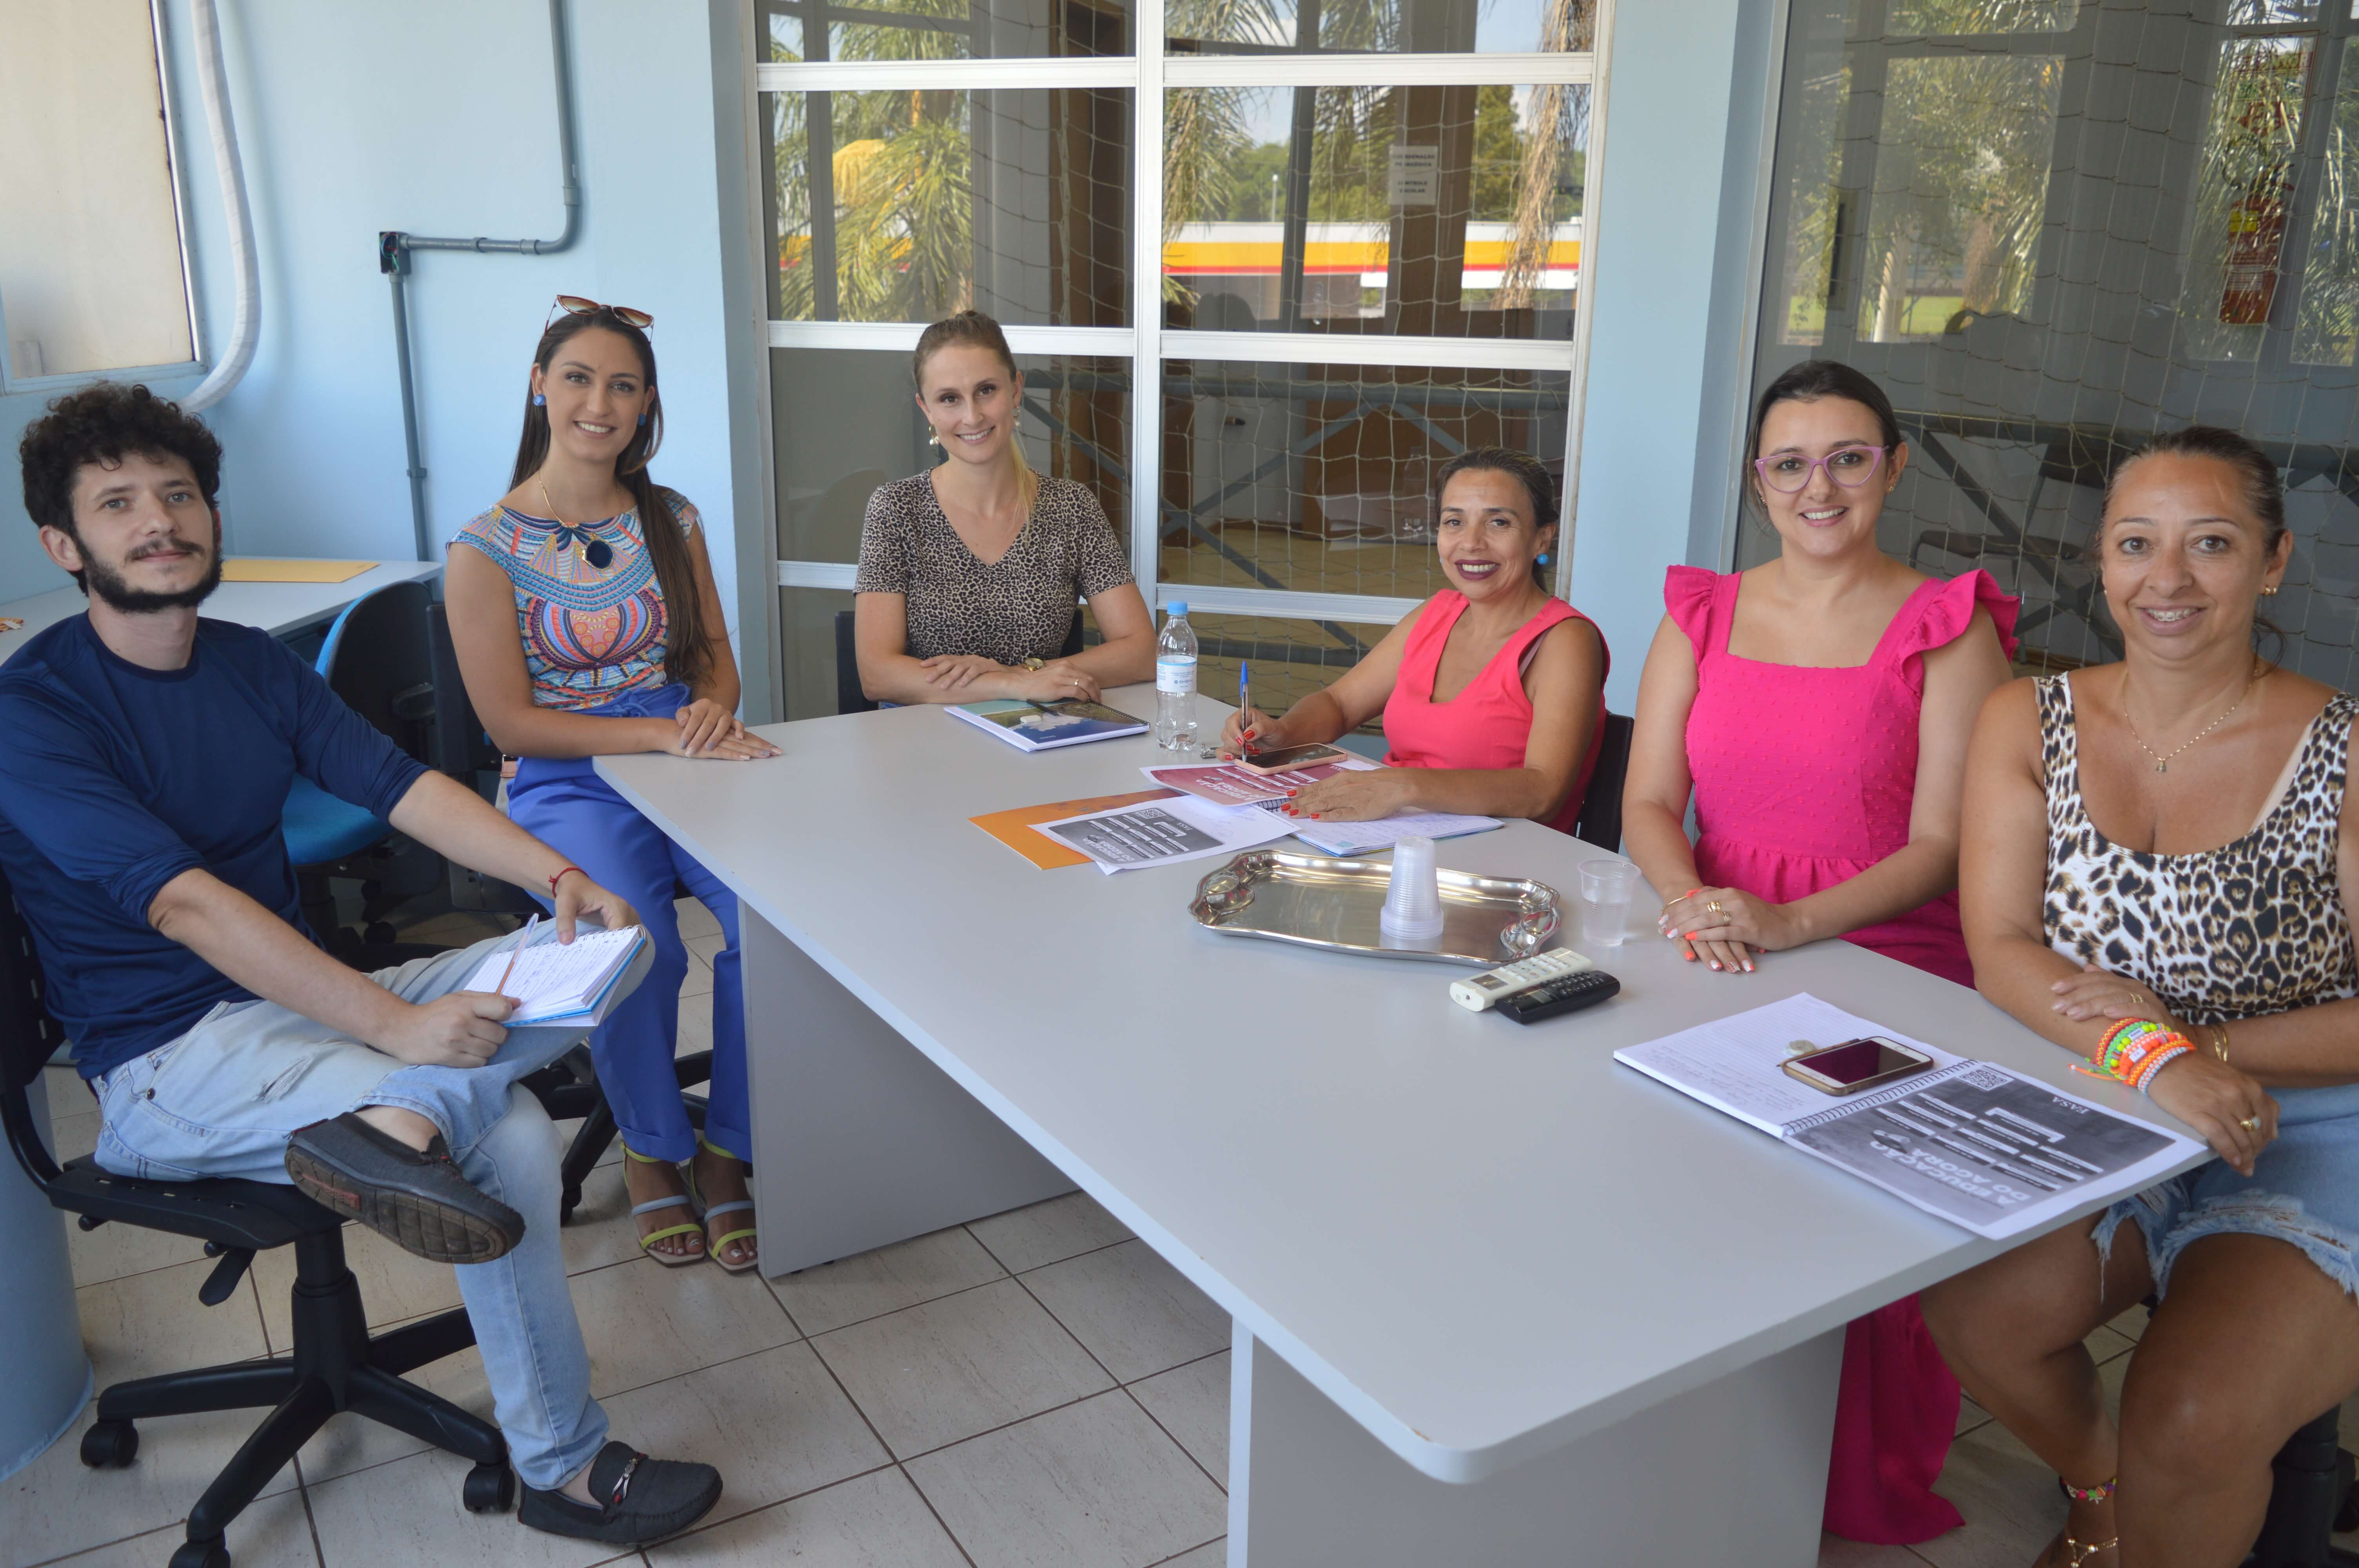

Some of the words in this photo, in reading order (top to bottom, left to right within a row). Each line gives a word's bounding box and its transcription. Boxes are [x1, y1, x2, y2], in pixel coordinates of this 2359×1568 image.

[1083, 838, 1121, 858] EDUCAÇÃO
[1100, 841, 1123, 853] AGORA
[2053, 1096, 2090, 1114] FASA
[1869, 1141, 1993, 1197] EDUCAÇÃO
[1913, 1147, 1993, 1182] AGORA
[1992, 1185, 2032, 1201] DO
